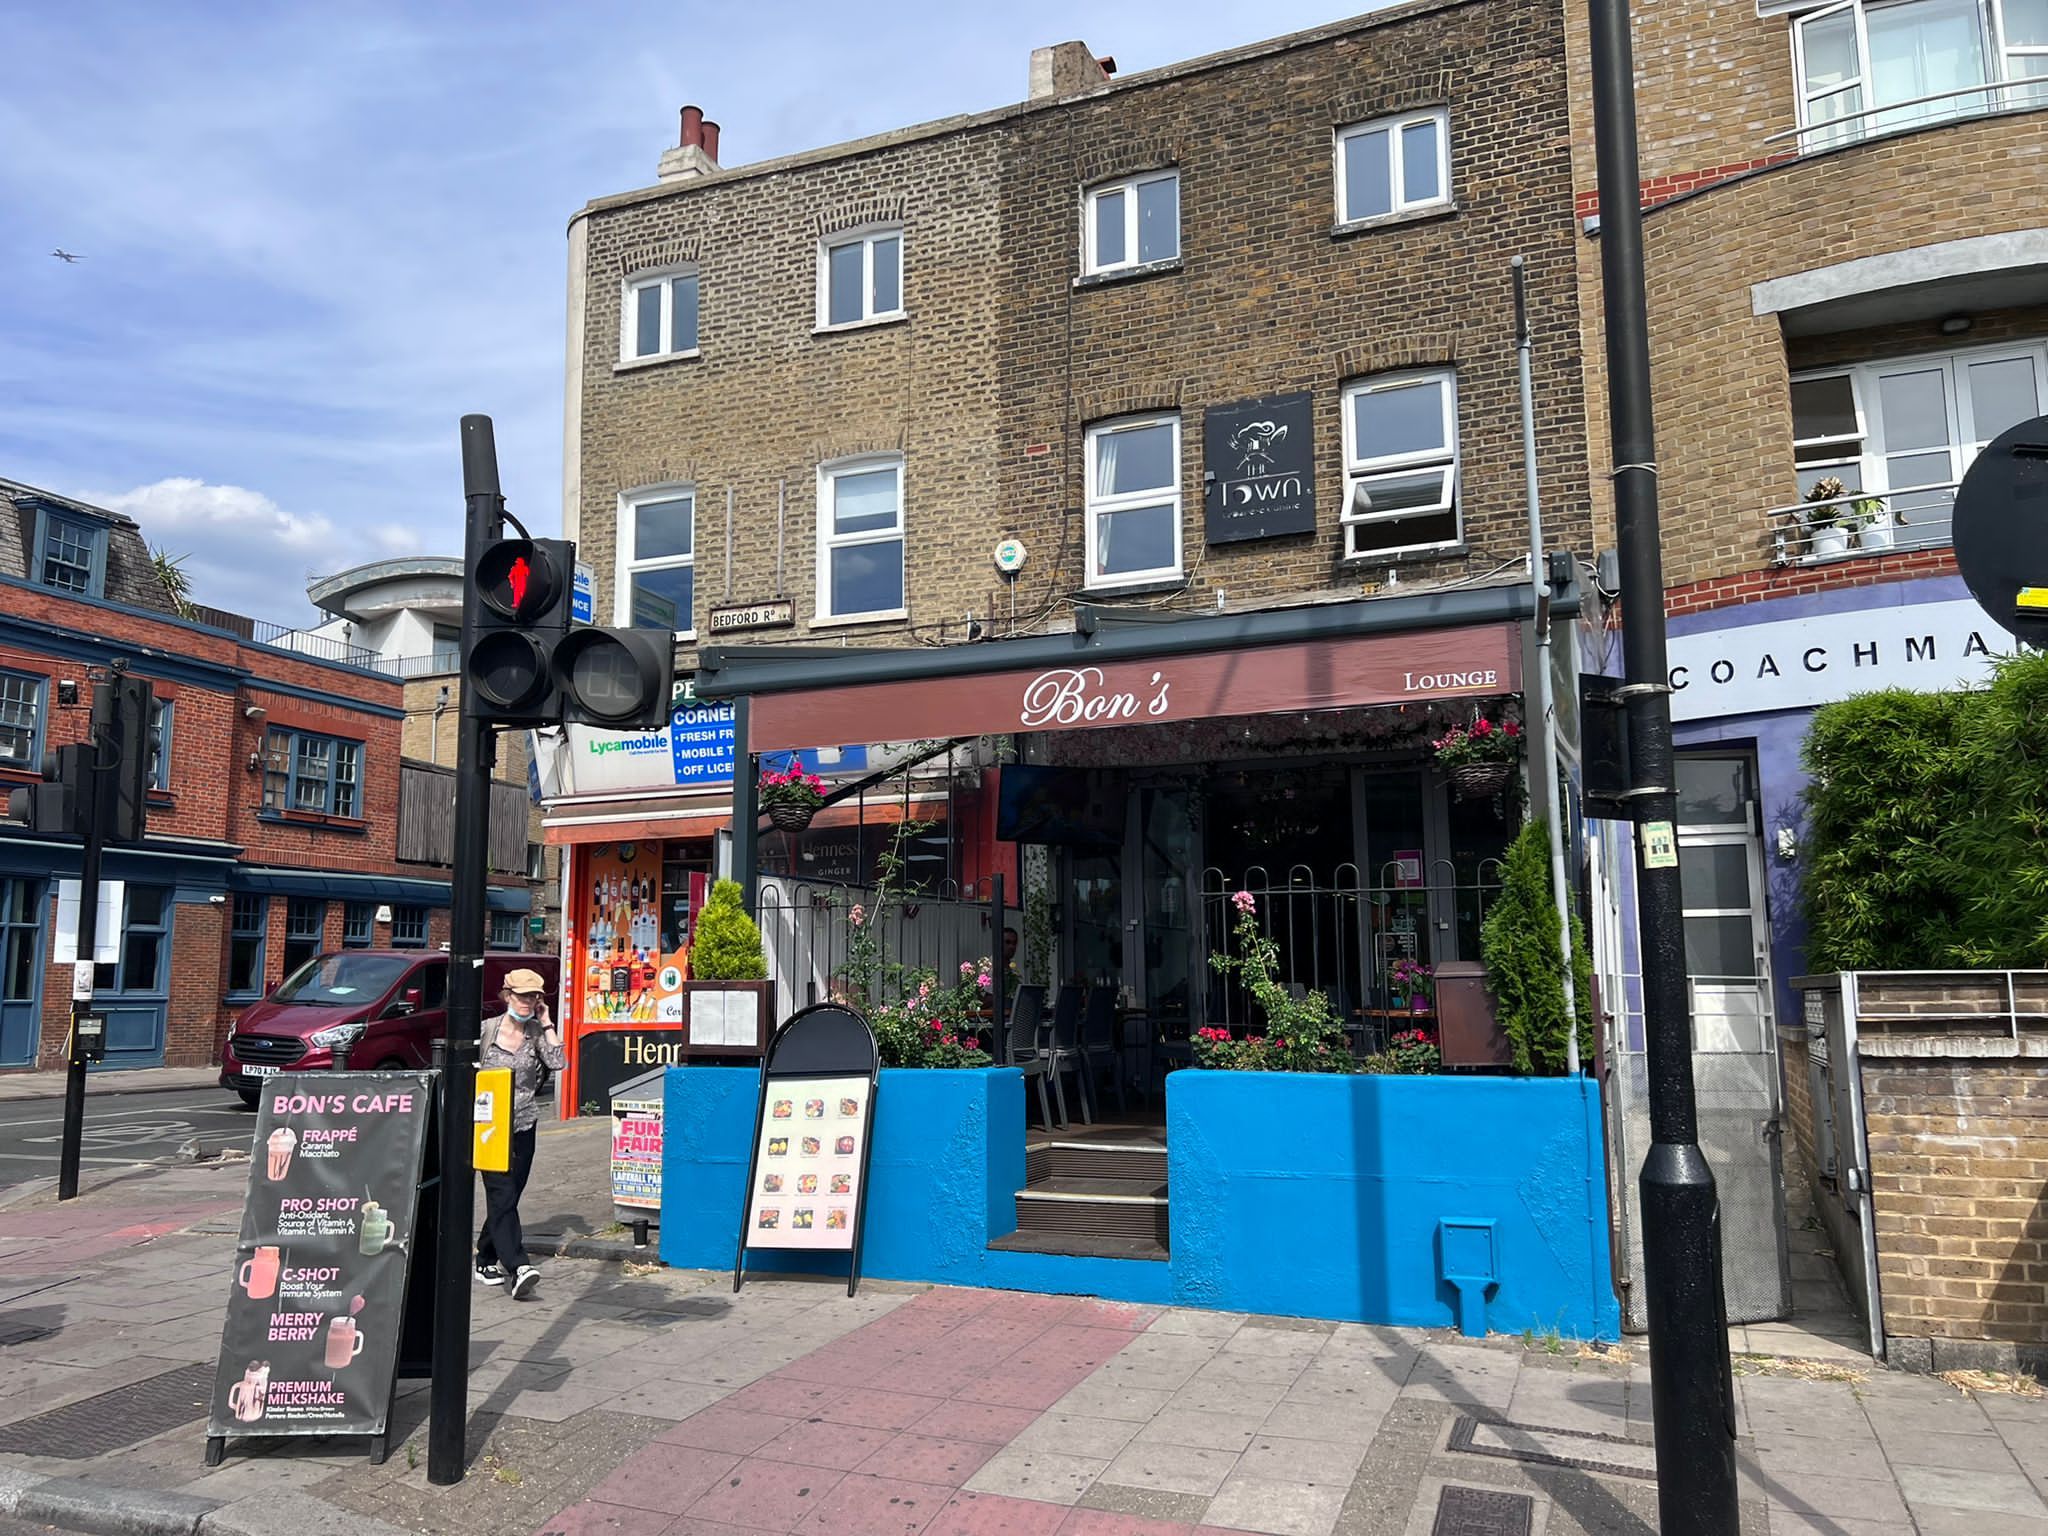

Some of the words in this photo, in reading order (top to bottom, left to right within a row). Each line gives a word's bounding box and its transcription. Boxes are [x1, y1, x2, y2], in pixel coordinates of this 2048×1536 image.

[713, 611, 759, 627] BEDFORD
[1669, 631, 1990, 690] COACHMA
[1020, 666, 1170, 727] Bon's
[680, 730, 716, 743] FRESH
[590, 735, 667, 755] Lycamobile
[681, 746, 724, 759] MOBILE
[682, 764, 704, 776] OFF
[707, 762, 735, 774] LICE
[818, 867, 852, 877] GINGER
[272, 1095, 346, 1114] BON'S
[352, 1094, 413, 1113] CAFE
[302, 1127, 358, 1142] FRAPPÉ
[622, 1121, 660, 1136] FUN
[300, 1142, 334, 1150] Caramel
[618, 1136, 663, 1152] FAIR
[299, 1149, 340, 1158] Macchiato
[280, 1199, 313, 1211] PRO
[316, 1198, 359, 1211] SHOT
[278, 1211, 331, 1220] Anti-Oxidant,
[278, 1219, 305, 1228] Source
[306, 1218, 315, 1226] of
[316, 1218, 346, 1227] Vitamin
[277, 1227, 306, 1236] Vitamin
[318, 1226, 347, 1235] Vitamin
[282, 1267, 340, 1281] C-SHOT
[280, 1282, 304, 1291] Boost
[305, 1282, 325, 1291] Your
[279, 1289, 311, 1298] Immune
[312, 1288, 342, 1299] System
[270, 1312, 324, 1326] MERRY
[268, 1327, 318, 1341] BERRY
[268, 1381, 332, 1393] PREMIUM
[267, 1392, 345, 1405] MILKSHAKE
